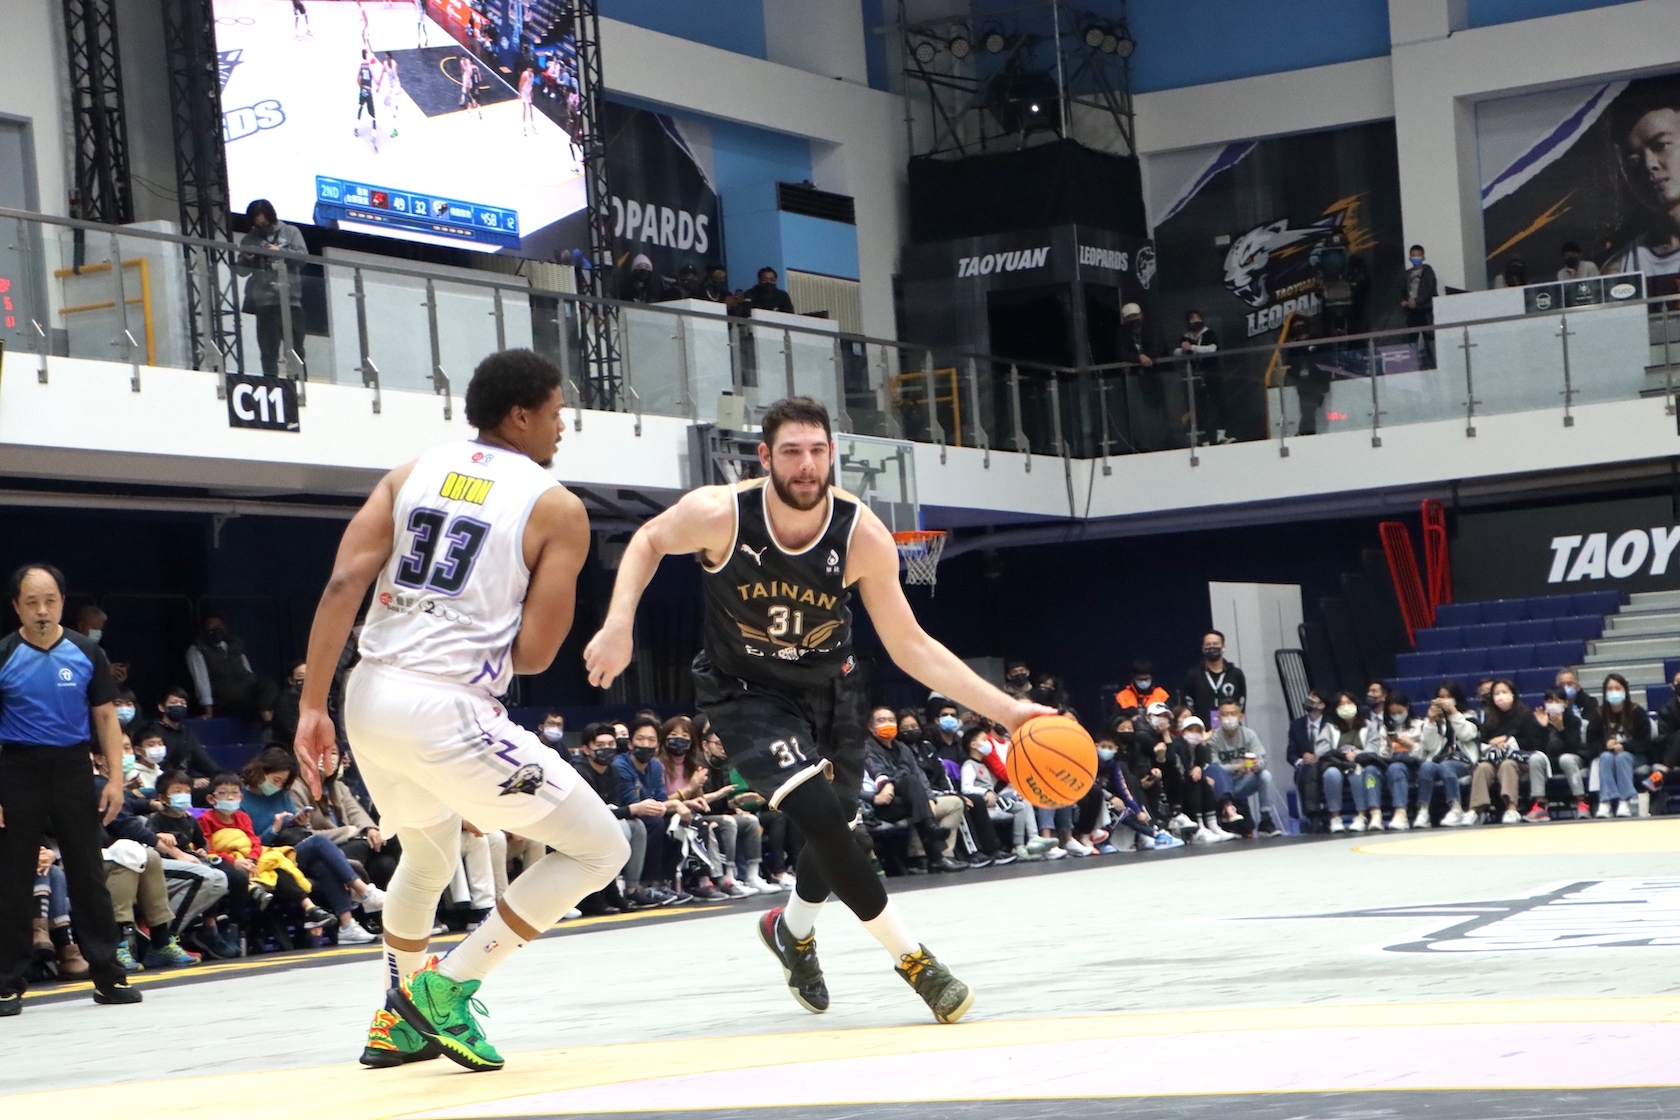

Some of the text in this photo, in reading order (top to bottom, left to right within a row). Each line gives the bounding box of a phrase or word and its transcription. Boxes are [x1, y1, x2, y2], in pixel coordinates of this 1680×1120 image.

[321, 184, 339, 199] 2ND
[393, 197, 406, 212] 49
[415, 200, 427, 215] 32
[958, 246, 1051, 278] TAOYUAN
[1079, 245, 1129, 272] LEOPARDS
[232, 382, 286, 424] C11
[439, 471, 495, 506] ORTON
[394, 506, 492, 597] 33
[1547, 525, 1680, 584] TAOY
[737, 580, 837, 610] TAINAN
[767, 604, 804, 637] 31
[769, 735, 808, 769] 31
